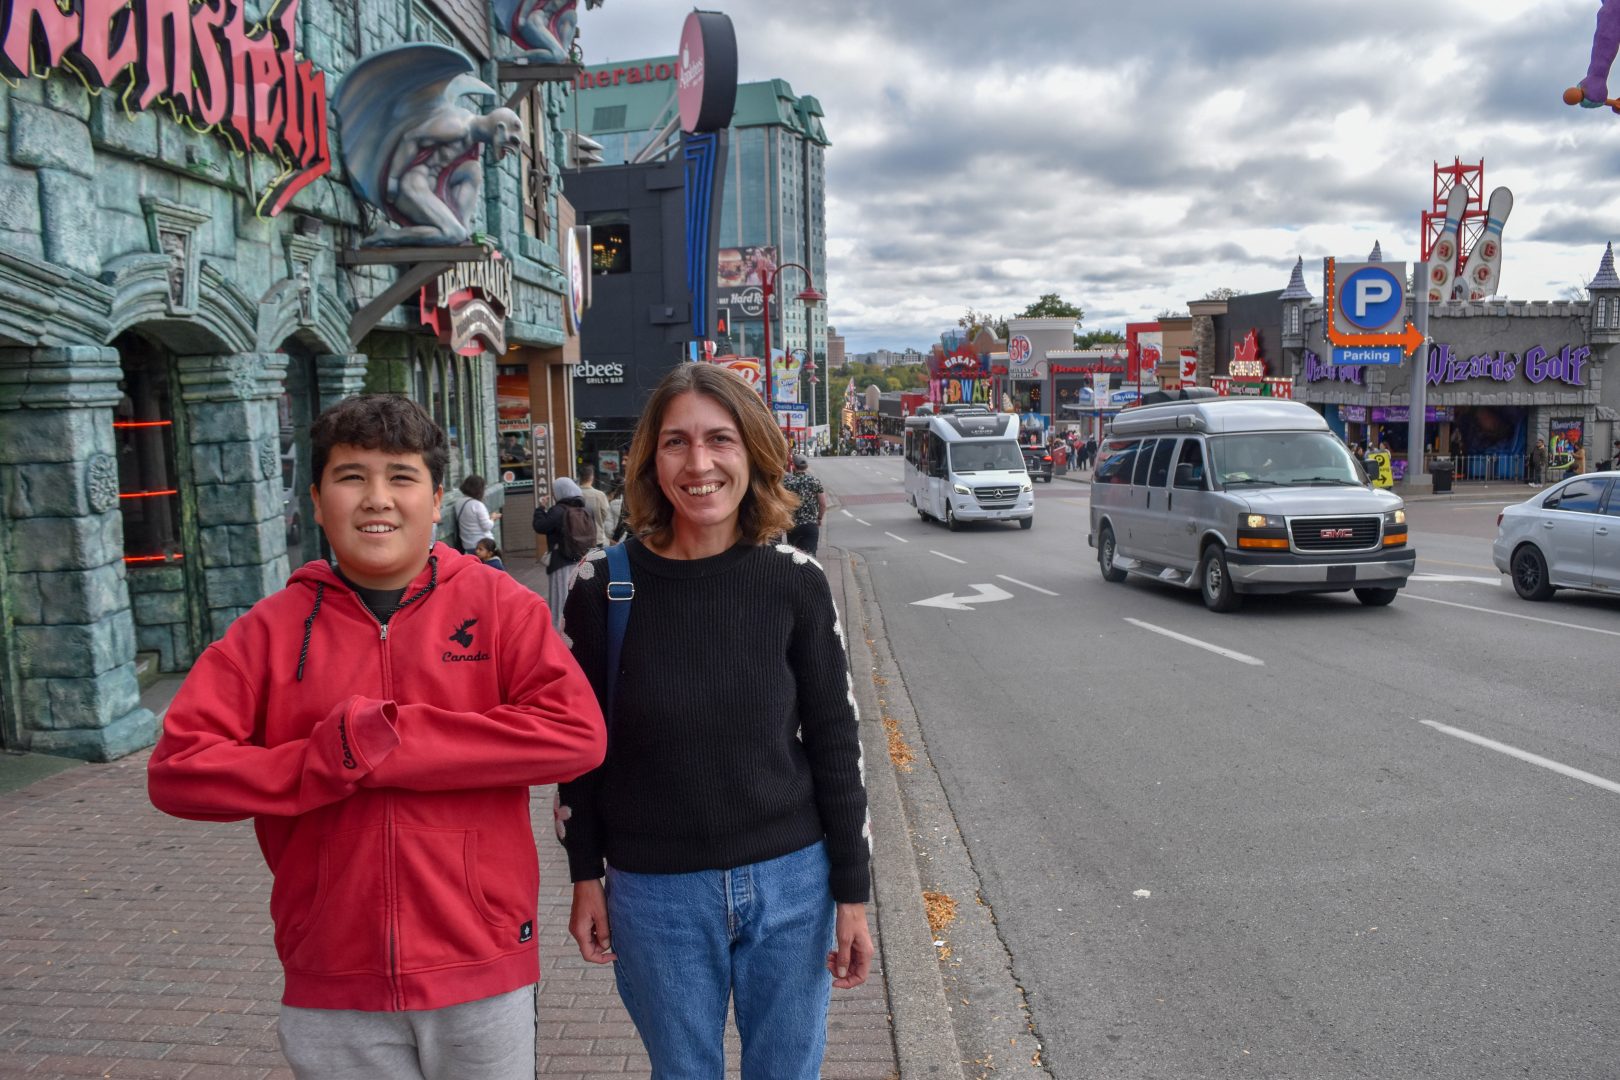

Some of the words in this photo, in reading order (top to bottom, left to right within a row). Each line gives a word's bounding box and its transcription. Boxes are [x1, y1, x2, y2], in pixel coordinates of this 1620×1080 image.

[1355, 279, 1392, 317] P
[944, 355, 976, 368] GREAT
[1343, 351, 1390, 362] Parking
[1229, 361, 1263, 376] CANADA
[1525, 344, 1591, 386] Golf
[1320, 528, 1353, 538] GMC
[442, 650, 491, 662] Canada
